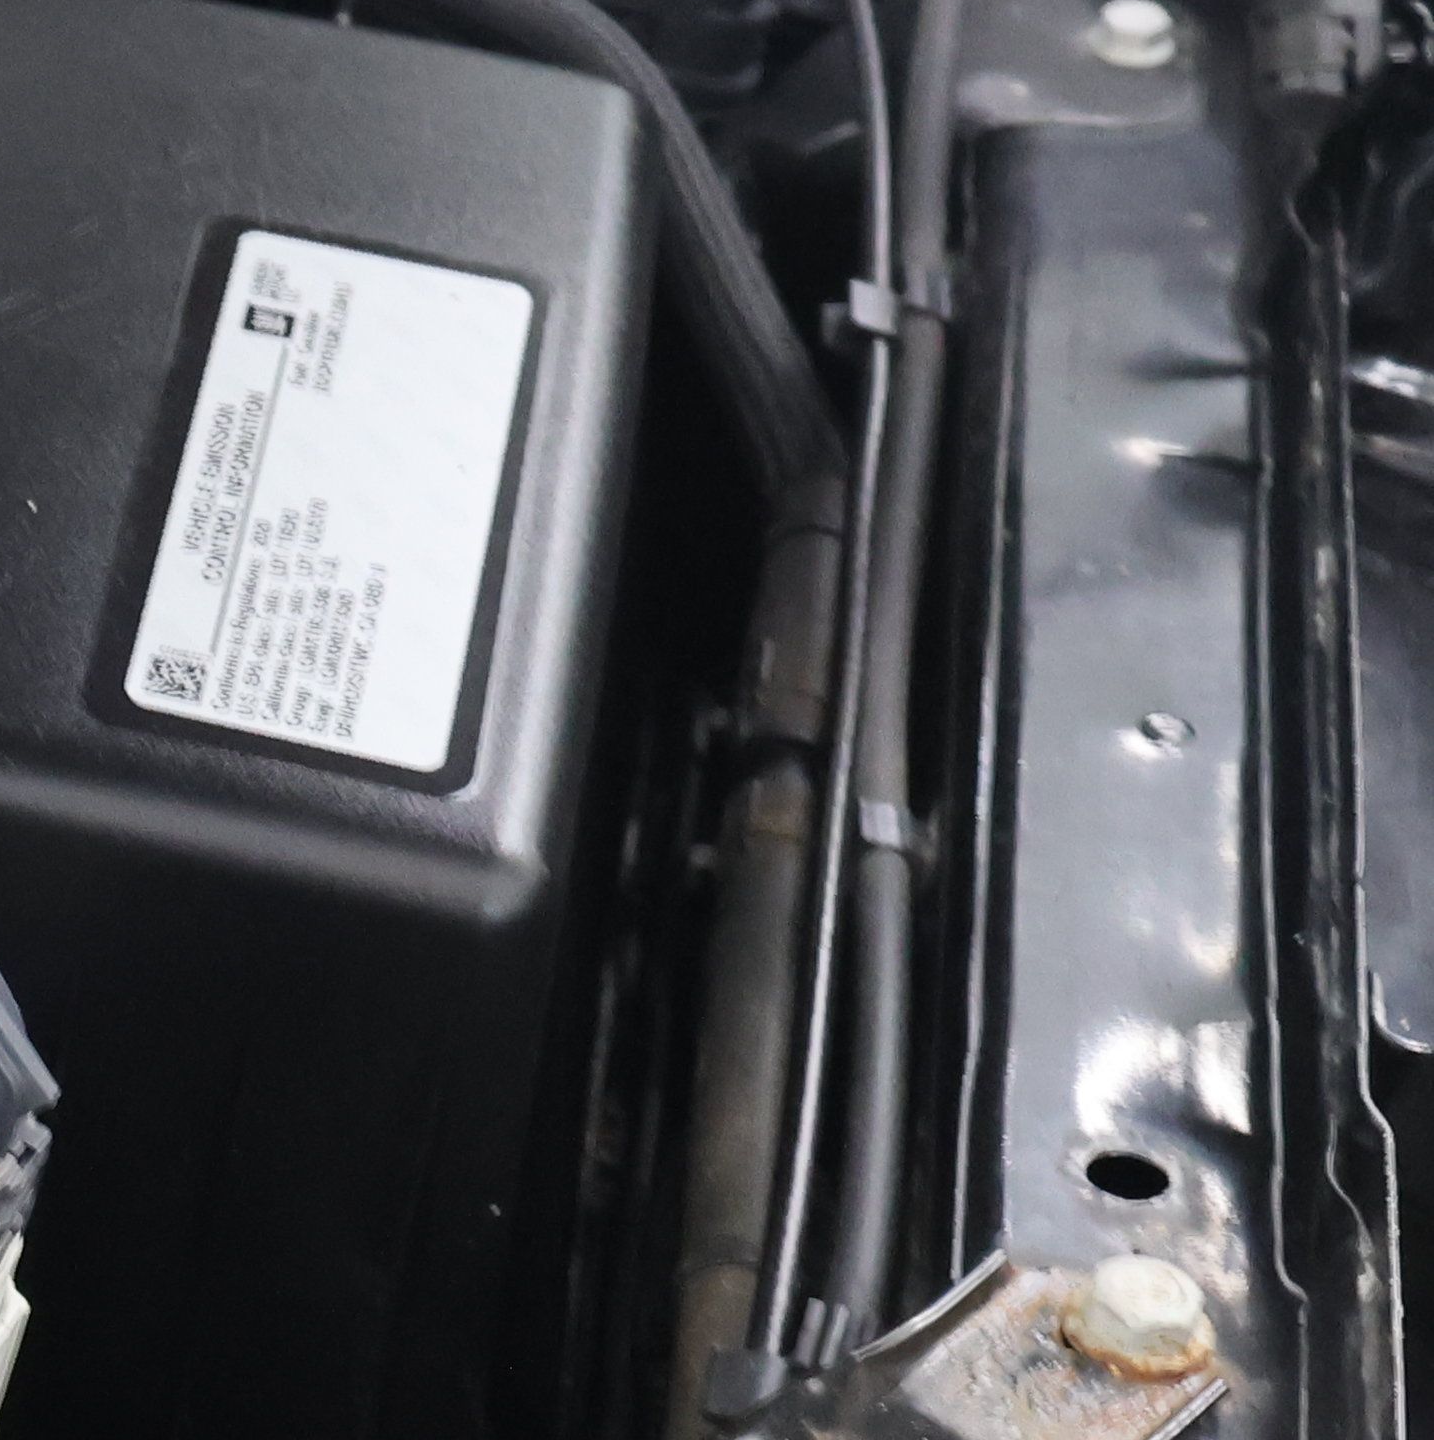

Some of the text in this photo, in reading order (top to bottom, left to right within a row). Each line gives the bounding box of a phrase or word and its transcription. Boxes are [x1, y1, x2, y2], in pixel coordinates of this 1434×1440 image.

[182, 403, 235, 552] VEHICLE EMISSION
[201, 390, 265, 585] CONTROL INFORMATION
